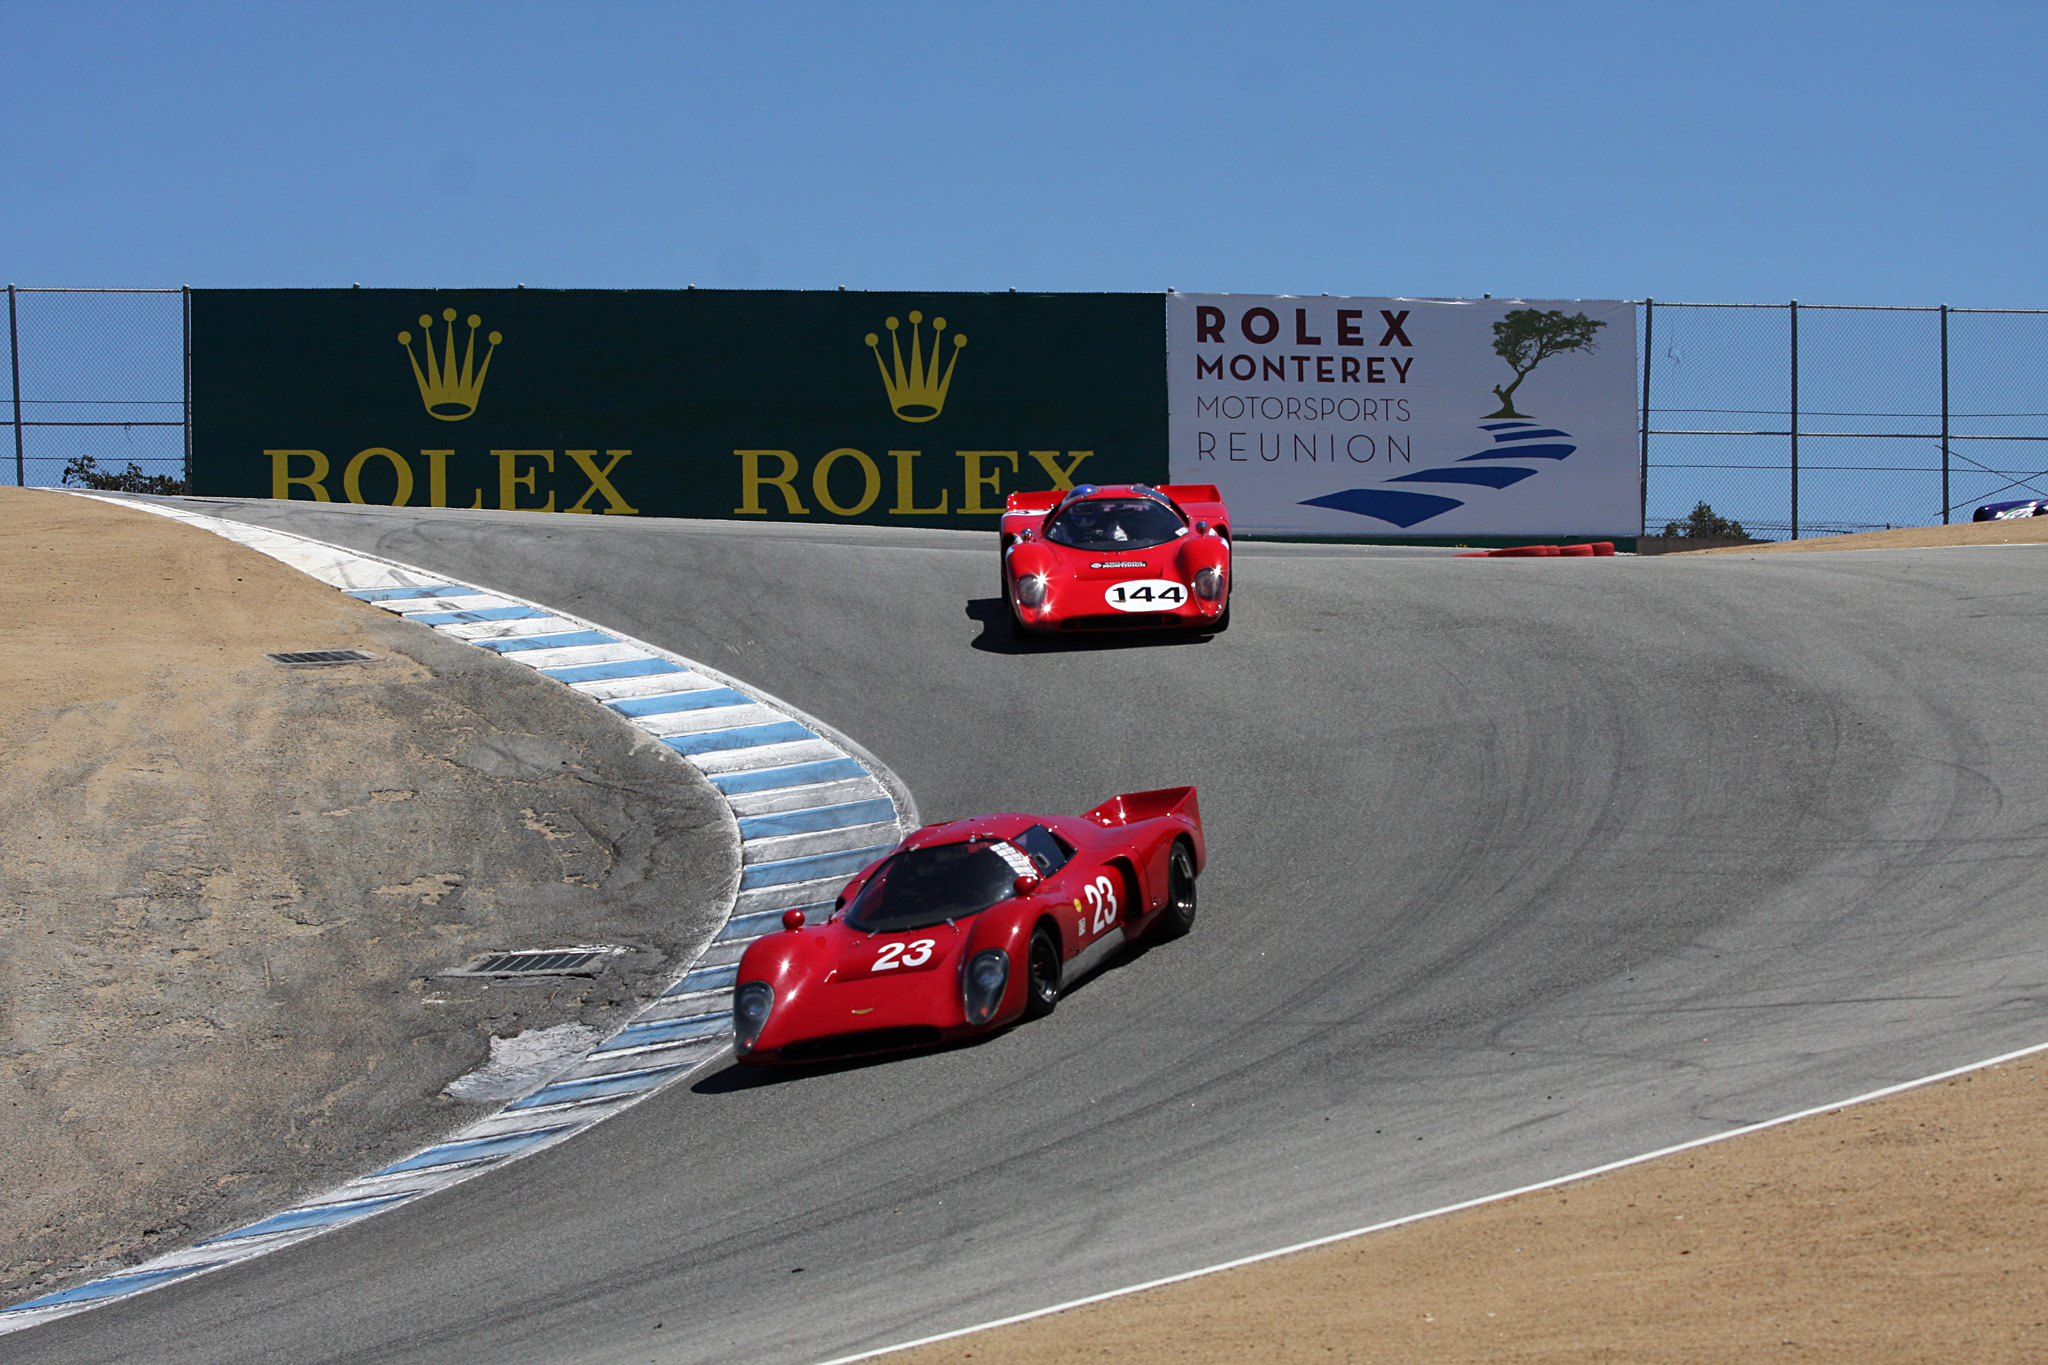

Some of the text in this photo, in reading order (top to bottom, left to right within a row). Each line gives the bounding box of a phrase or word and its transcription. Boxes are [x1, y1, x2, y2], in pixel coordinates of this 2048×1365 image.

[1196, 305, 1413, 347] ROLEX
[1196, 354, 1414, 384] MONTEREY
[1197, 396, 1411, 422] MOTORSPORTS
[1198, 432, 1411, 463] REUNION
[263, 447, 639, 514] ROLEX
[733, 447, 1094, 515] ROLEX
[1112, 586, 1184, 603] 144
[1083, 875, 1117, 935] 23
[871, 939, 936, 972] 23
